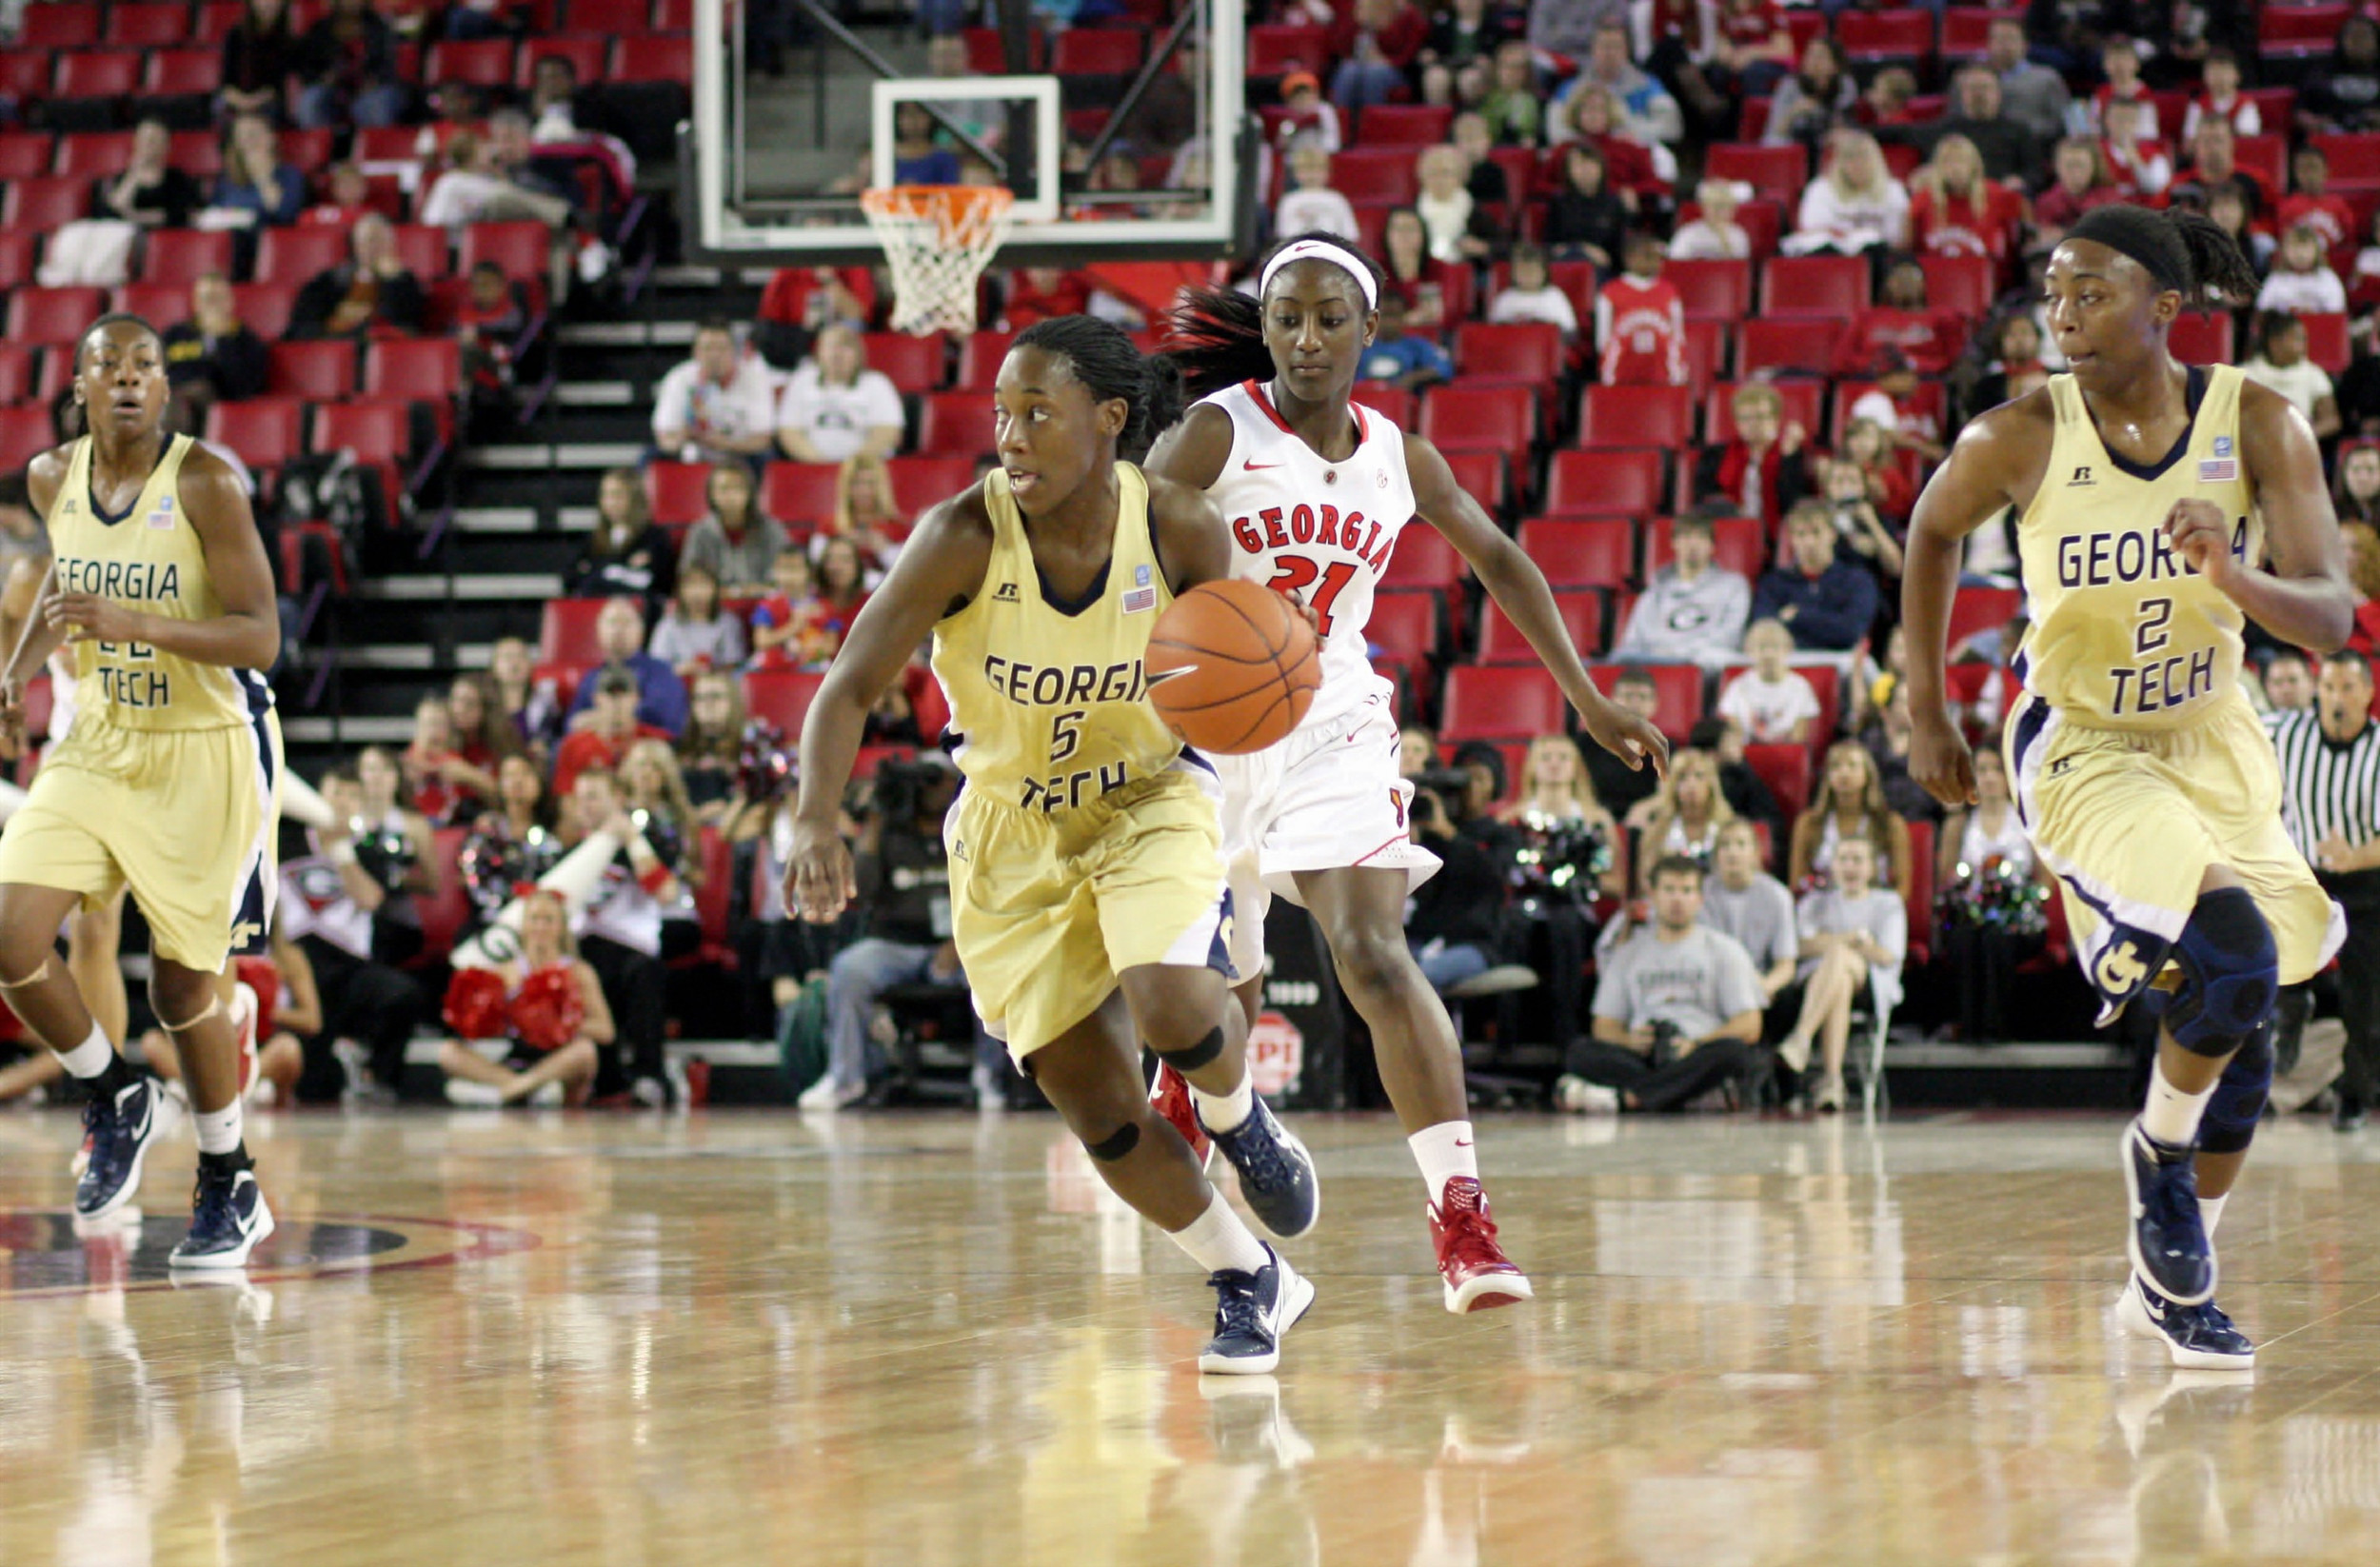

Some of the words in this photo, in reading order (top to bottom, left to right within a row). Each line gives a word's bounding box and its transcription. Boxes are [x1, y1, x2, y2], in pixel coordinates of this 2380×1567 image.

[1233, 504, 1393, 574] GEORGIA
[2057, 515, 2247, 587] GEORA
[2136, 598, 2172, 654] 2
[98, 668, 169, 707] TECH
[984, 654, 1148, 706] GEORGI
[2110, 646, 2216, 714] TECH
[1050, 710, 1085, 763] 5
